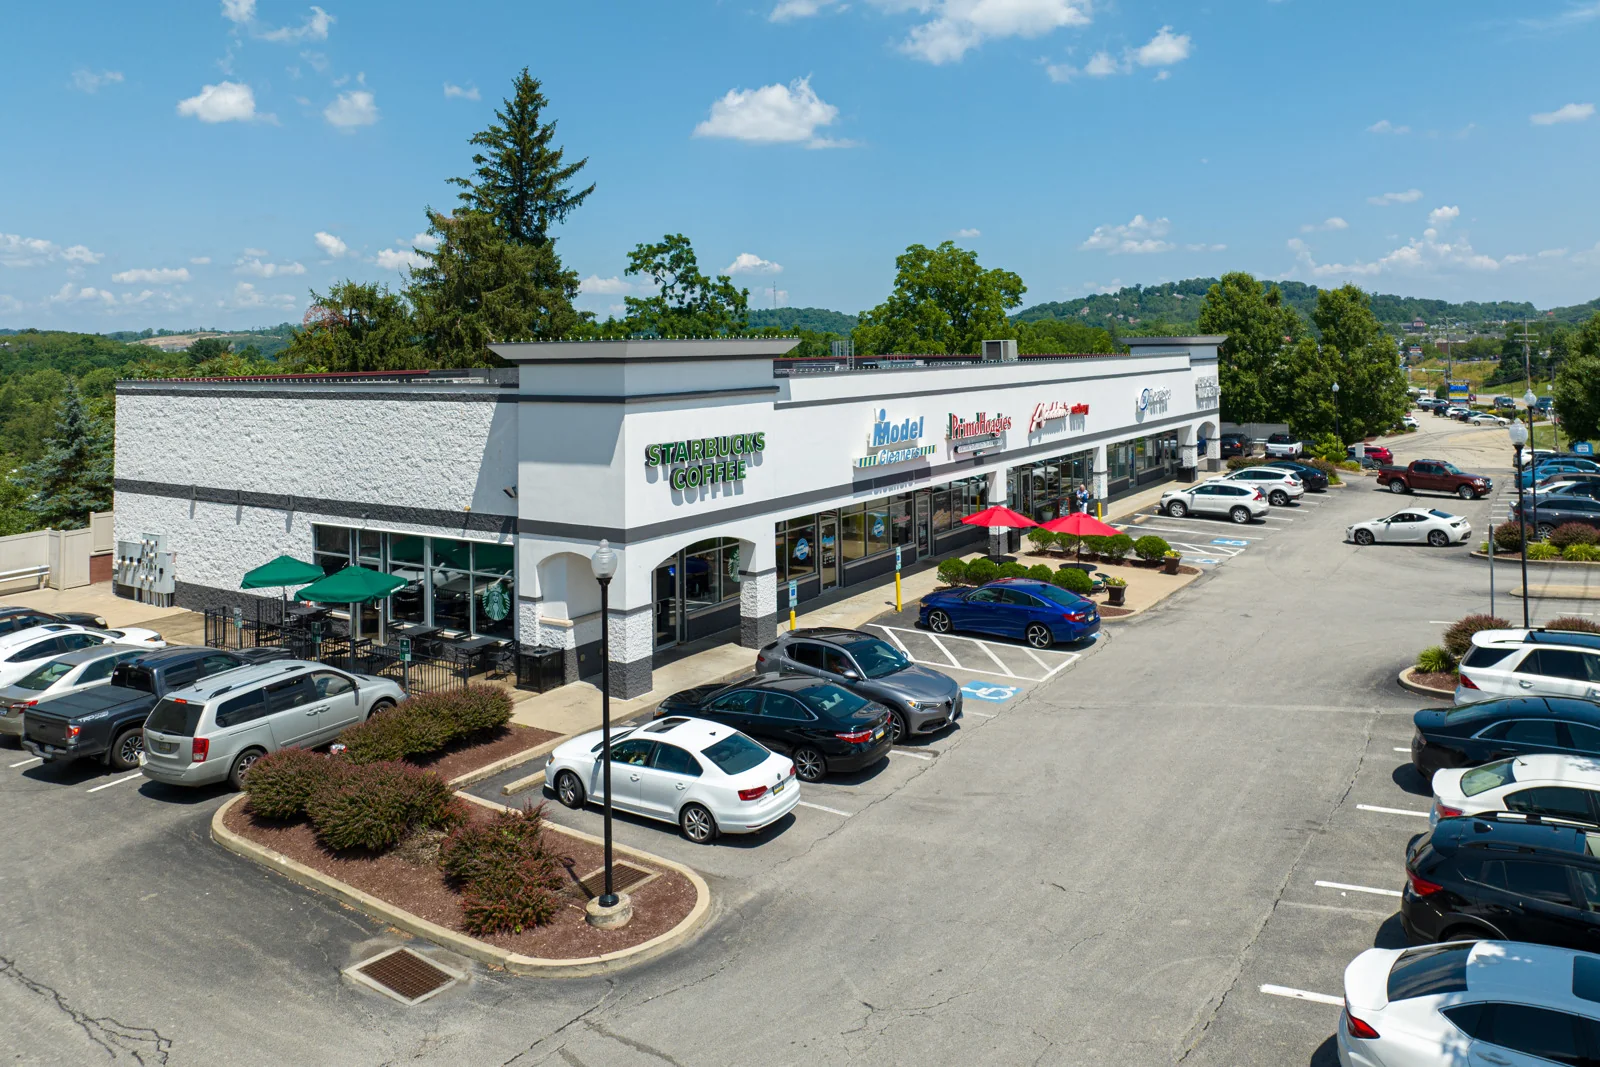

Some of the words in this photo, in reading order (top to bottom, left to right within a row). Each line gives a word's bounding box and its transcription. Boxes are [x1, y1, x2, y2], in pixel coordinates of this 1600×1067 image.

[872, 414, 925, 447] Model
[951, 412, 1012, 440] PrimoHoagies
[647, 432, 766, 467] STARBUCKS
[878, 447, 922, 466] Cleaners
[672, 459, 747, 491] COFFEE
